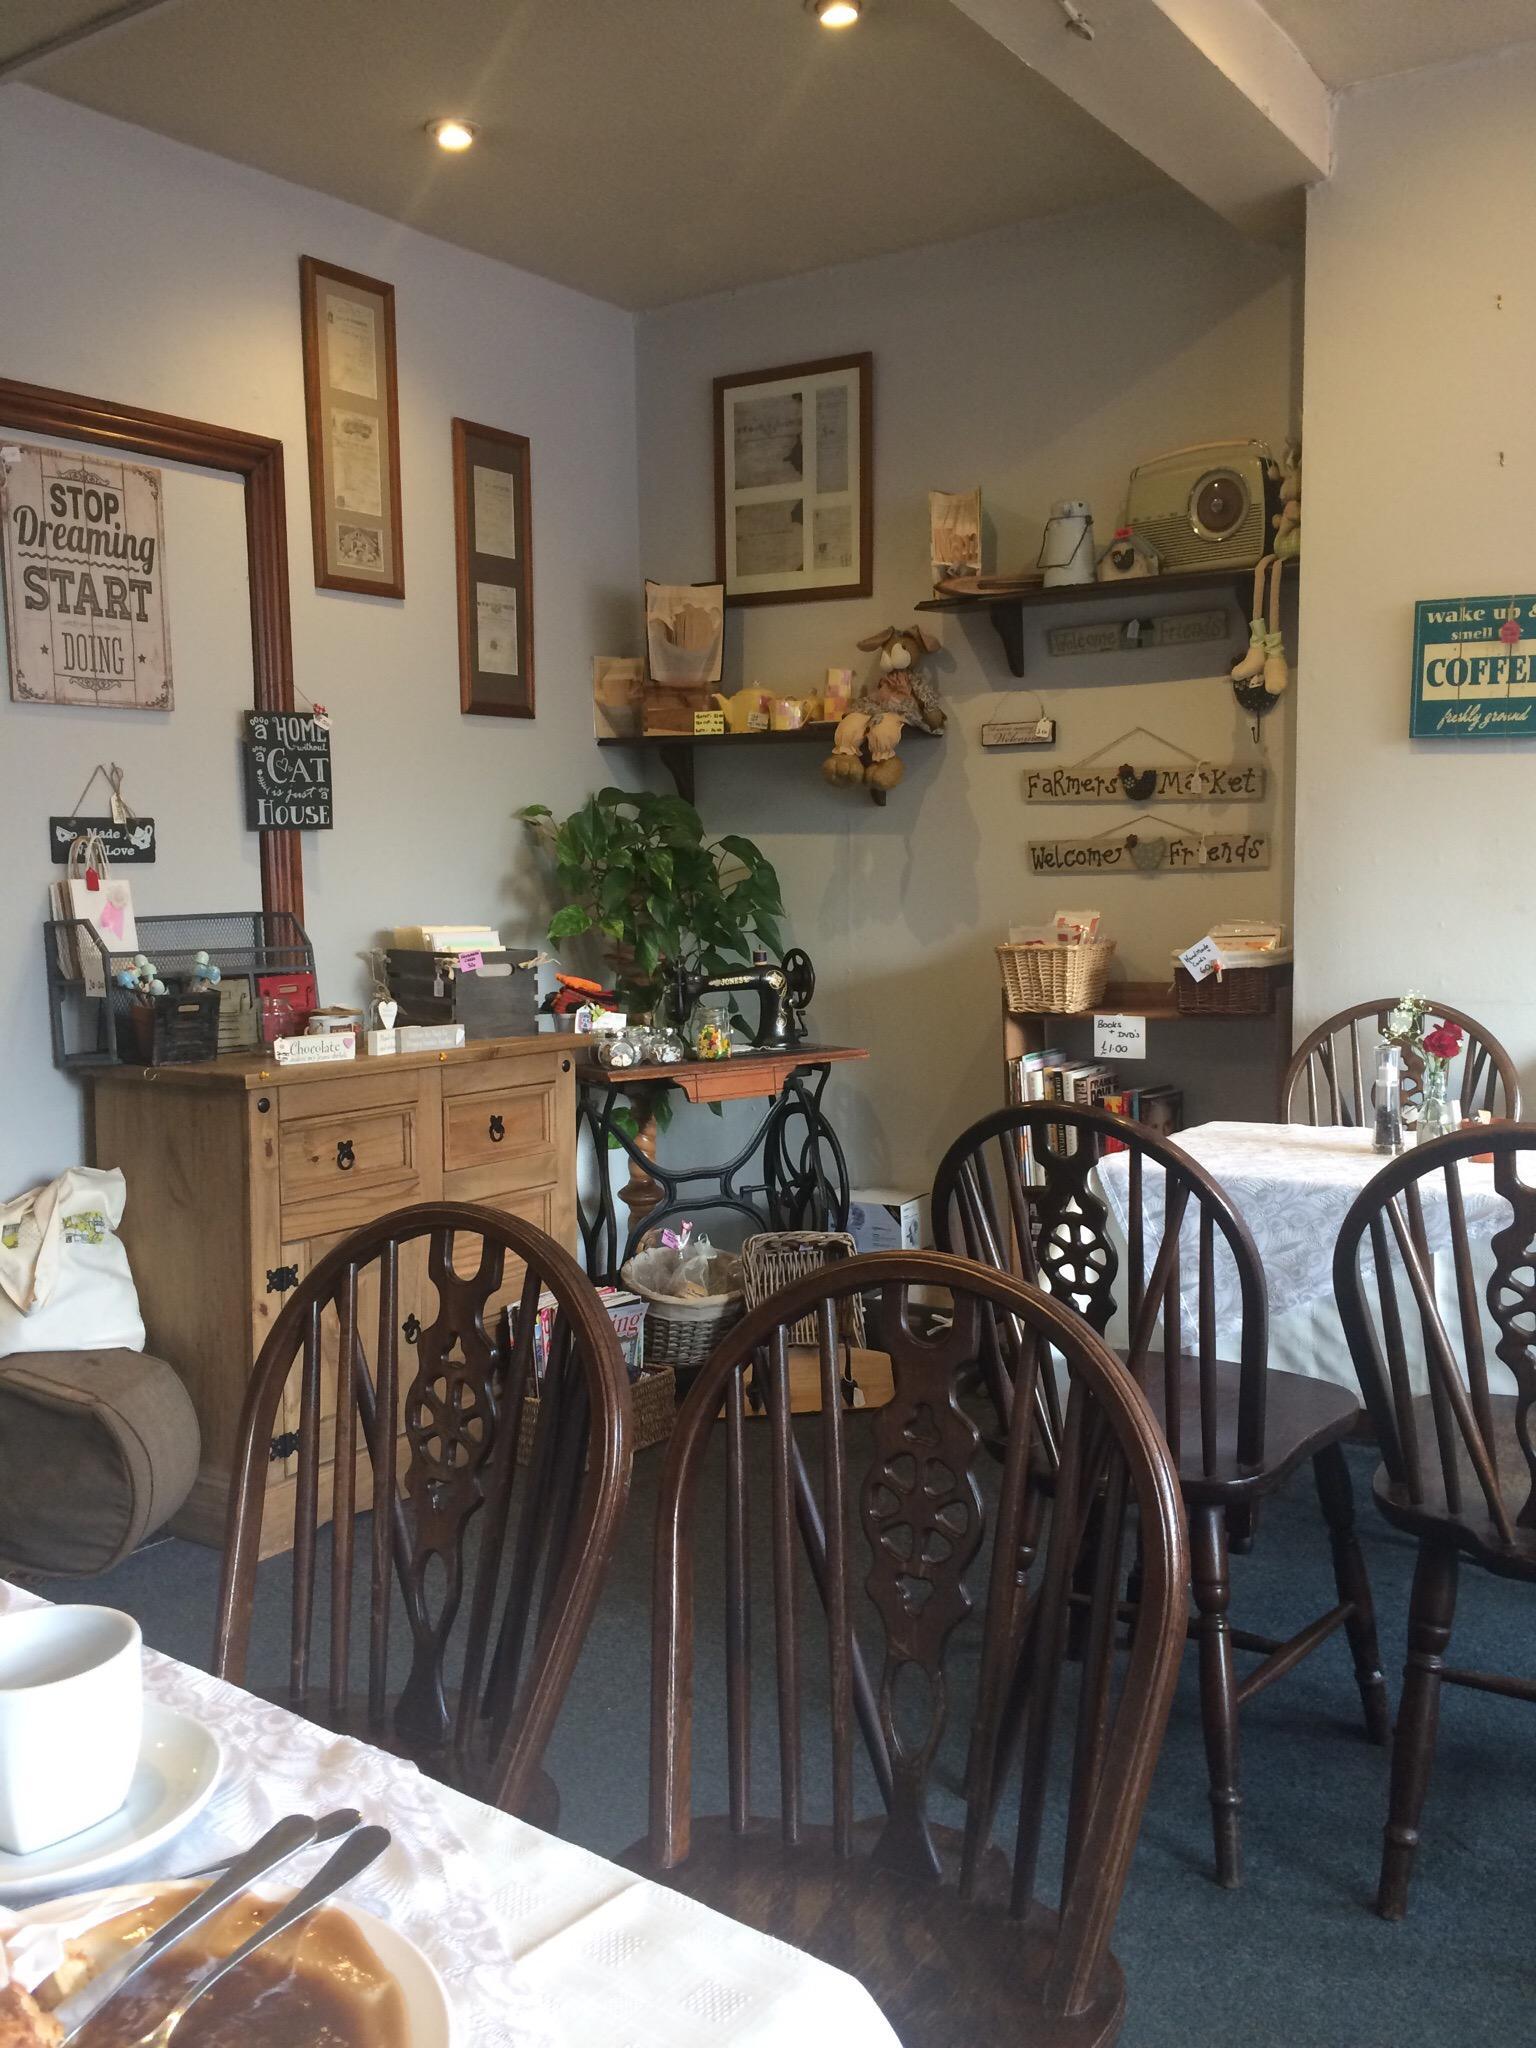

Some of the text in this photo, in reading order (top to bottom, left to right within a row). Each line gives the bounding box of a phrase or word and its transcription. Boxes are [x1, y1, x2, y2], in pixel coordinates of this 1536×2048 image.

[50, 482, 120, 525] STOP
[13, 505, 156, 575] Dreaming
[23, 565, 153, 622] START
[1427, 607, 1485, 623] wake
[1493, 607, 1521, 622] up
[1451, 627, 1493, 641] smell
[62, 632, 125, 675] DOING
[254, 724, 268, 740] a
[255, 748, 330, 784] a CAT
[272, 785, 284, 797] is
[285, 786, 317, 803] just
[257, 799, 330, 825] HOUSE
[87, 827, 121, 840] Made
[106, 845, 135, 856] Love
[1031, 835, 1265, 870] Welcome Frends
[720, 976, 743, 986] JONES
[1097, 1019, 1122, 1029] Books
[290, 1041, 340, 1056] Chocolate
[1101, 1040, 1128, 1056] £1.00
